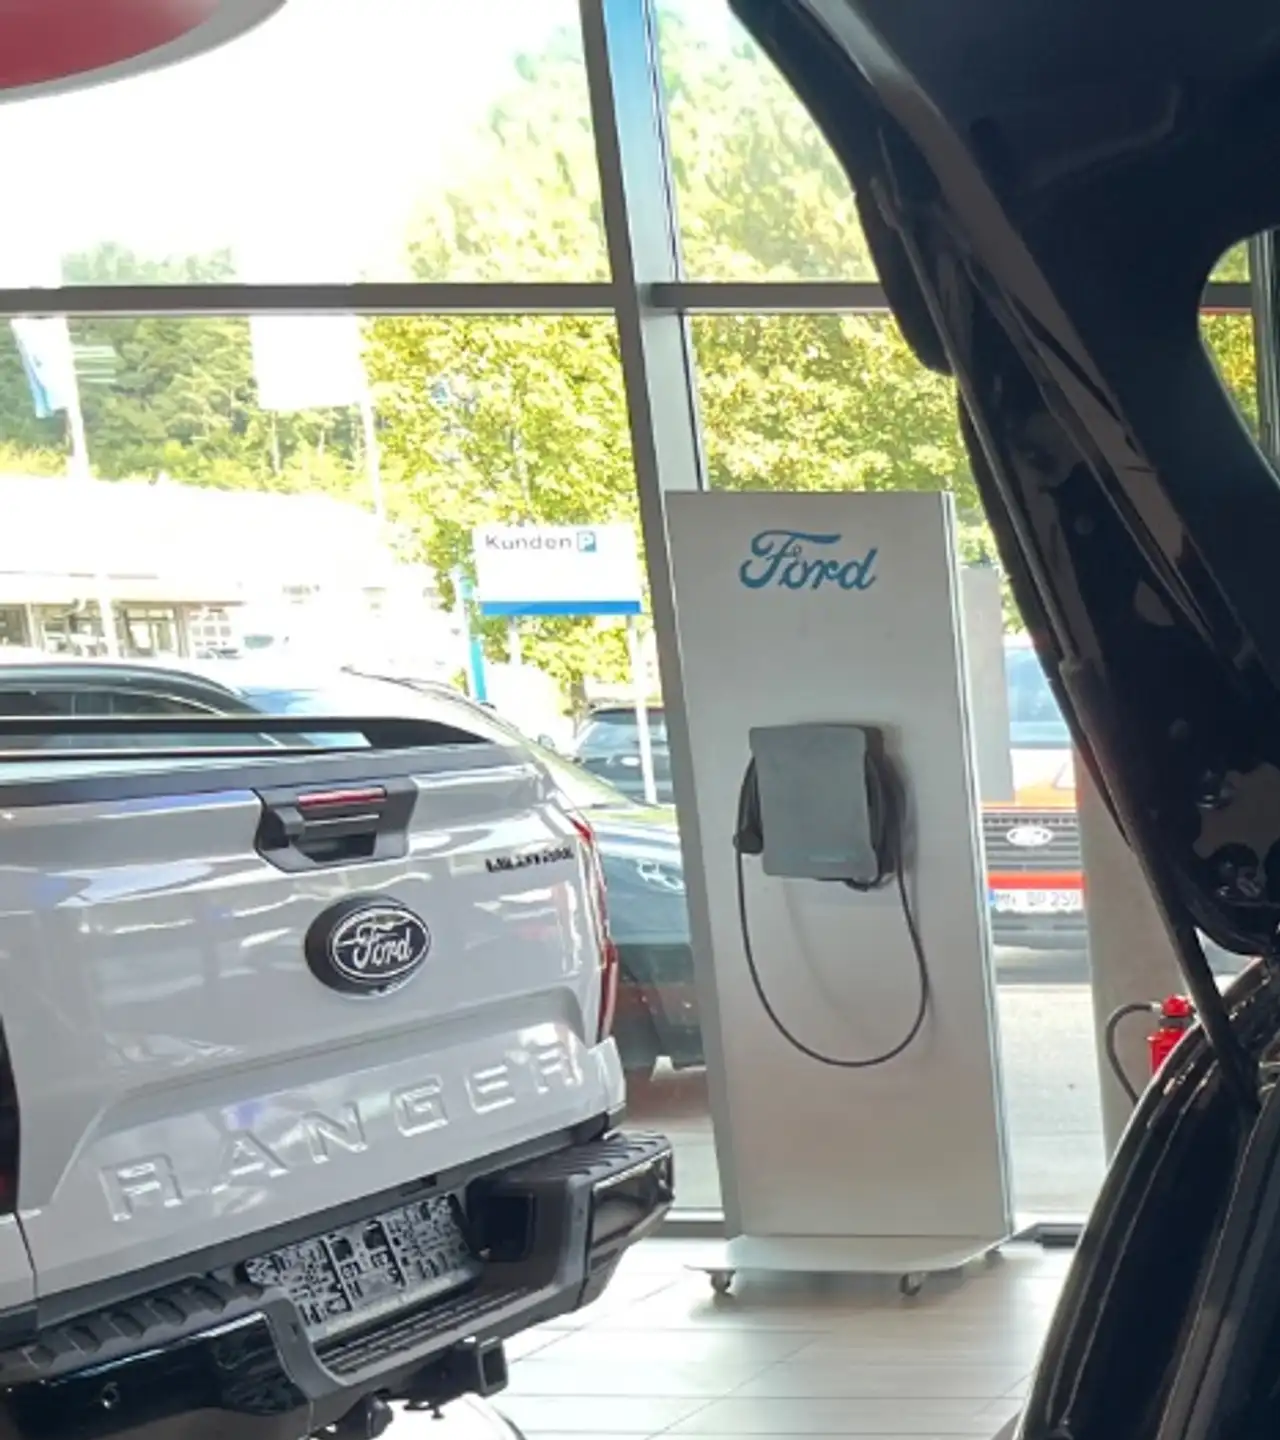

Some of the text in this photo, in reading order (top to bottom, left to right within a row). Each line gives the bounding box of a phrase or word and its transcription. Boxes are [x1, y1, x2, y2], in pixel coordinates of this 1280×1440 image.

[485, 534, 572, 550] Kunden
[739, 529, 878, 590] Ford
[353, 920, 413, 969] Ford
[99, 1042, 585, 1222] RANGER
